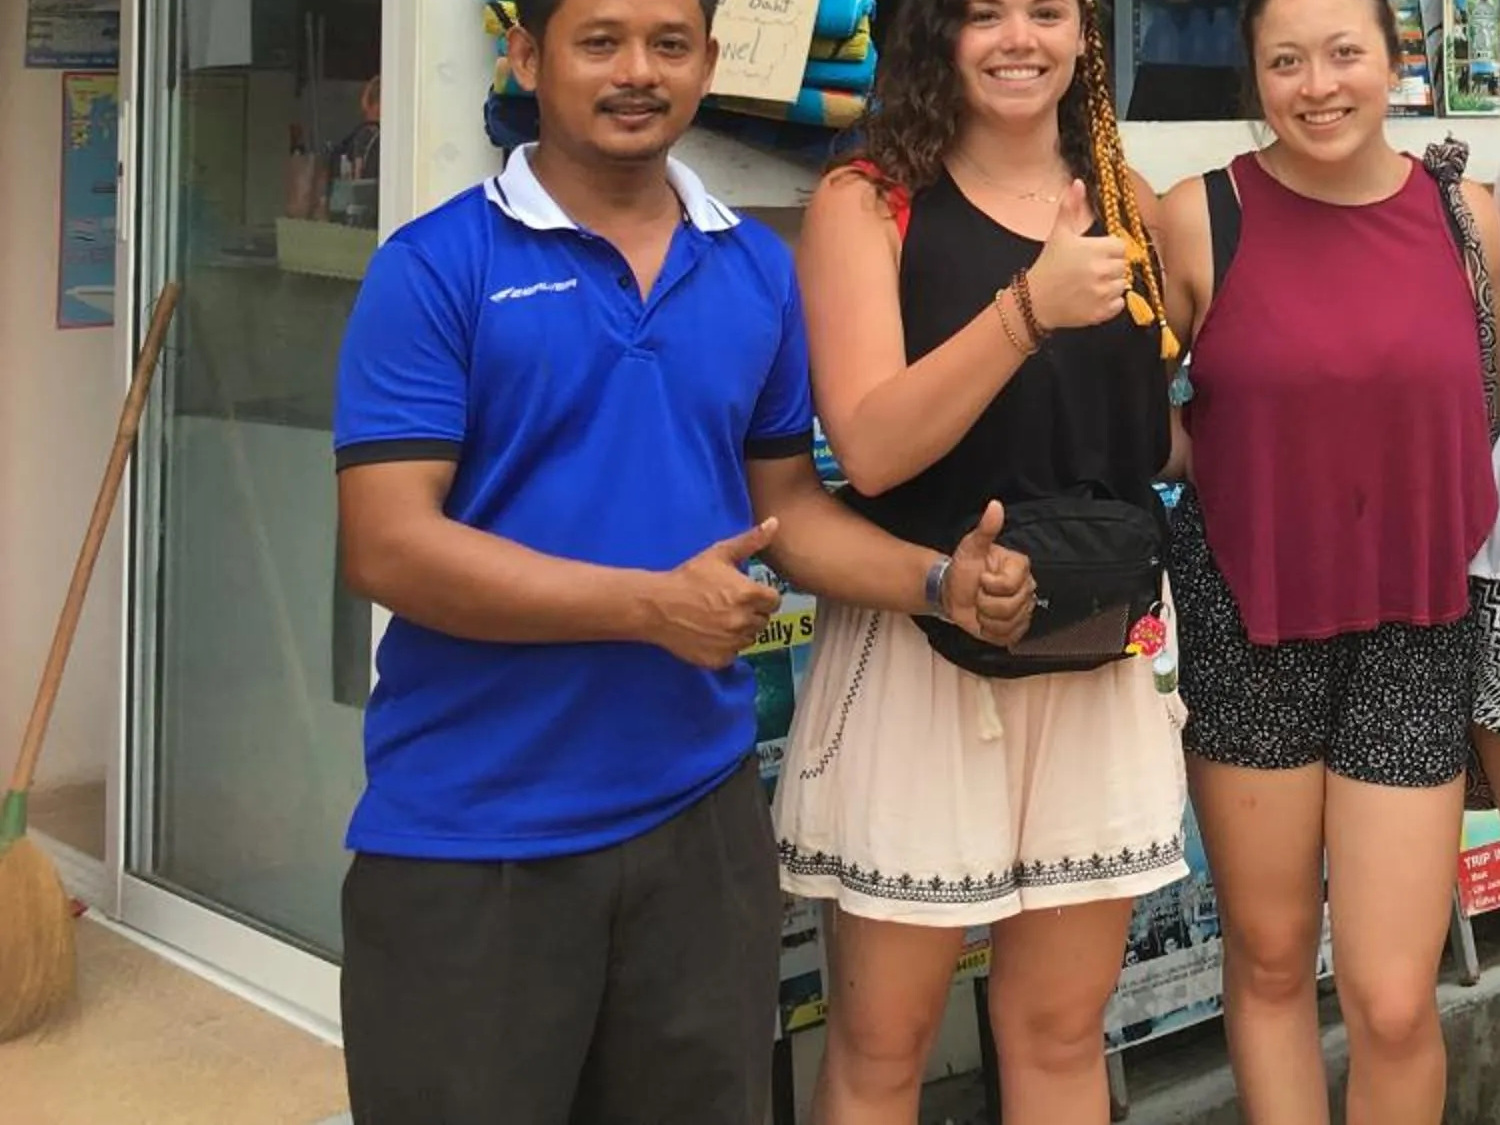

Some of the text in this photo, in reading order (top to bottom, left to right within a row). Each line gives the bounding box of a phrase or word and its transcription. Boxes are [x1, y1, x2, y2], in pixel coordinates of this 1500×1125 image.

[722, 26, 761, 65] wel
[757, 619, 793, 645] aily
[1464, 851, 1491, 871] TRIP
